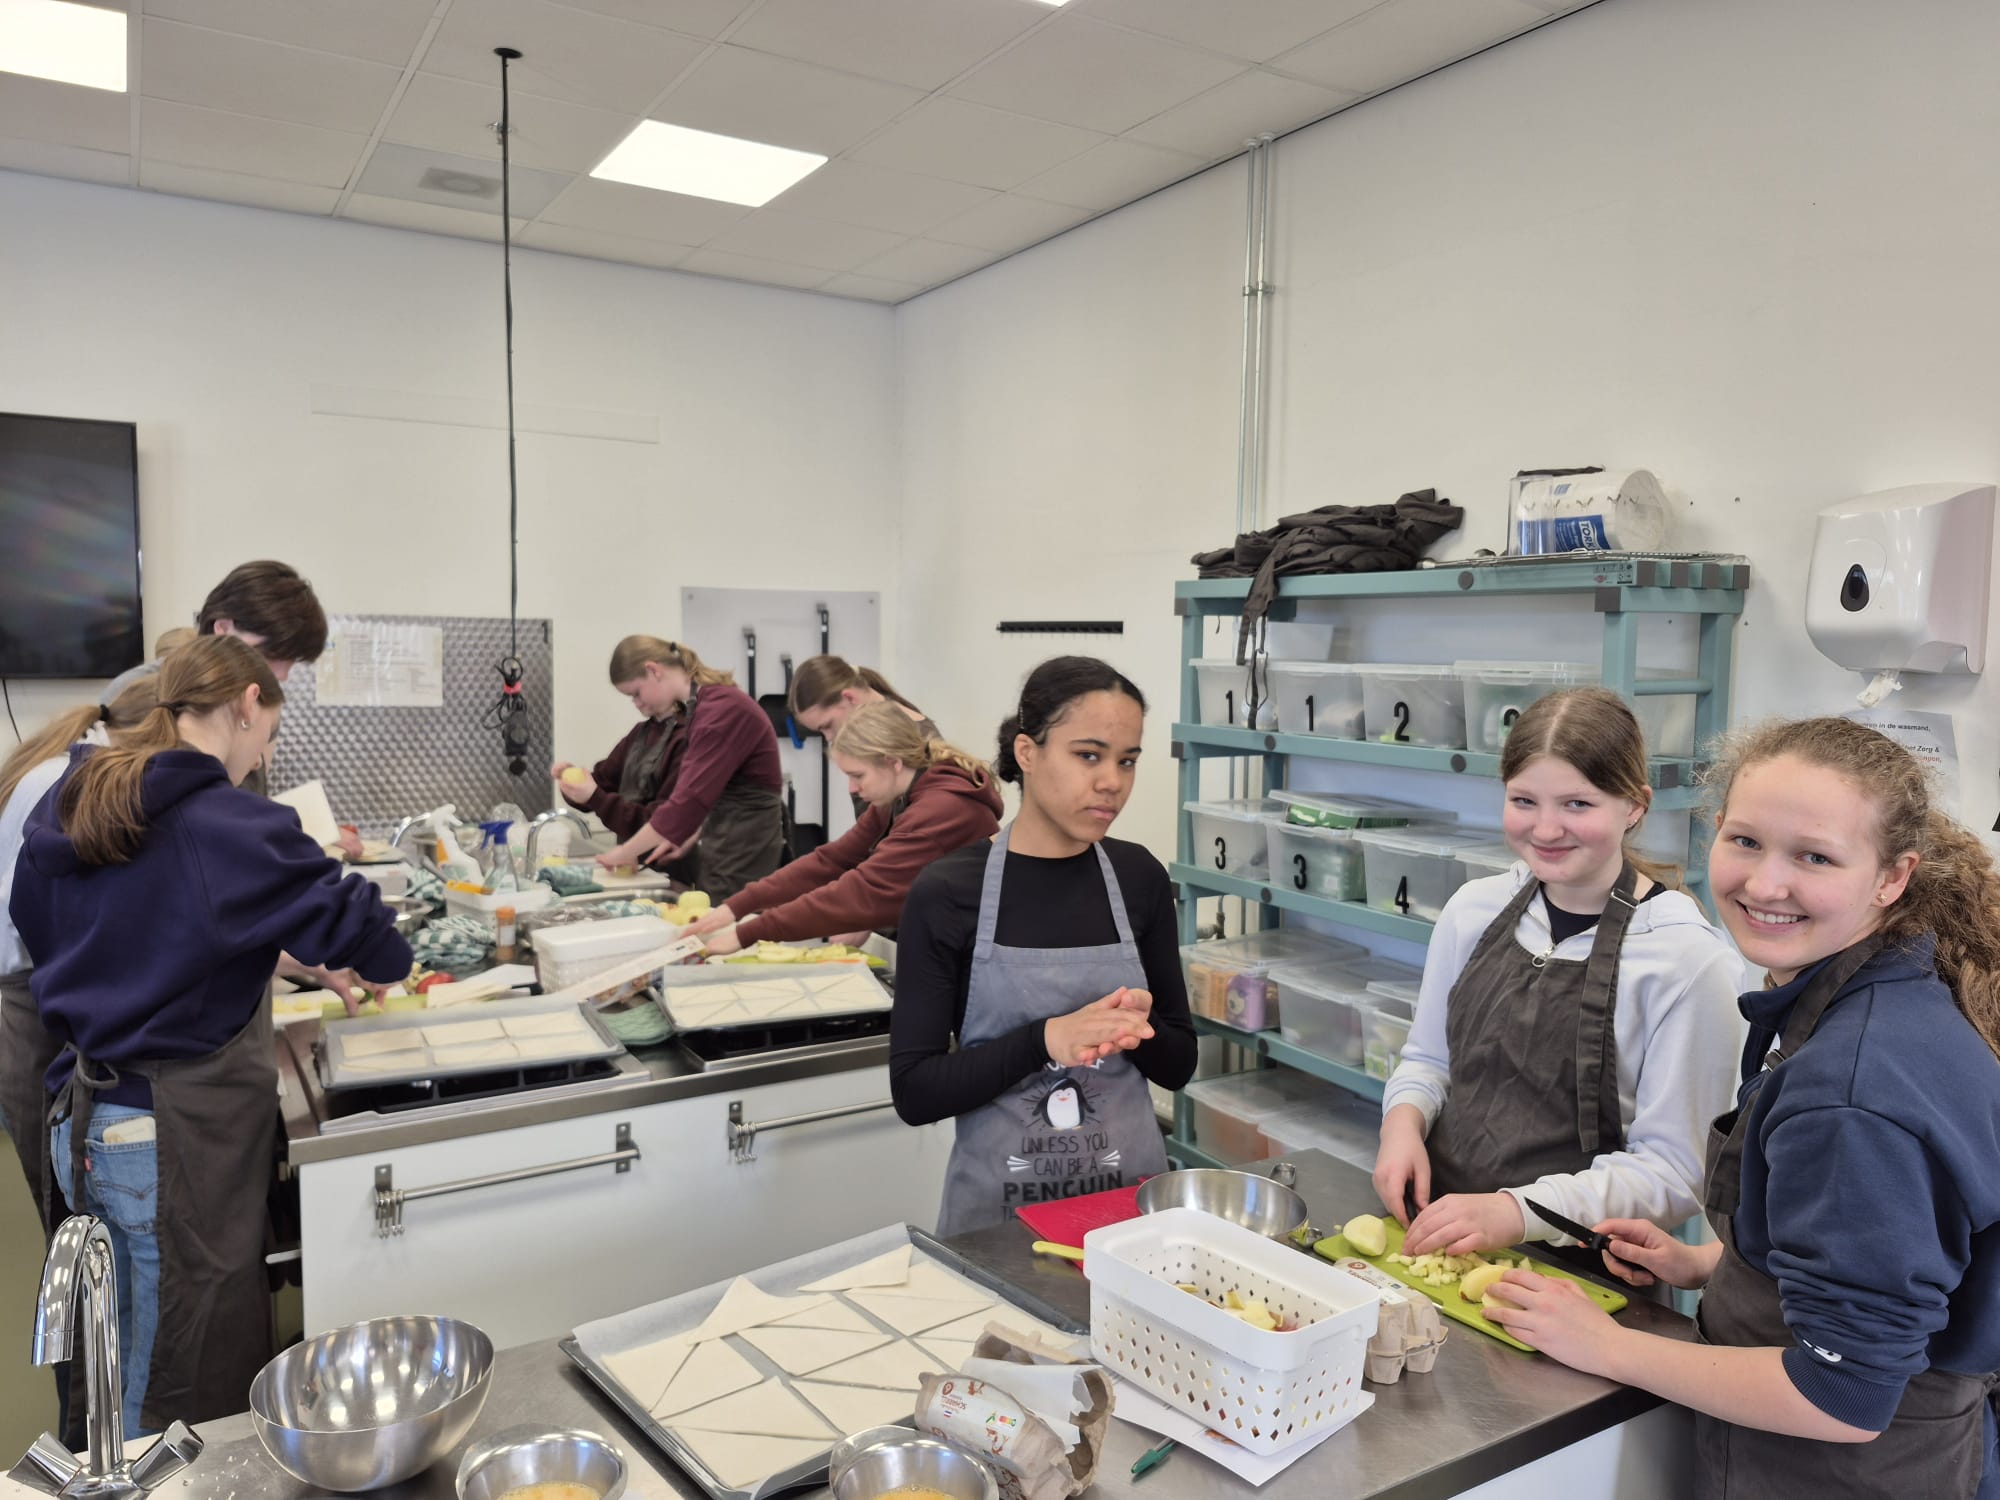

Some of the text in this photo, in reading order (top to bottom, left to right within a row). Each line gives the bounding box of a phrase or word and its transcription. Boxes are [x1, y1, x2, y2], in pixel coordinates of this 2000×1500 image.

[1581, 522, 1596, 548] TORK
[1225, 689, 1234, 725] 1
[1305, 694, 1314, 732] 1
[1393, 700, 1410, 742] 2
[1214, 836, 1226, 870] 3
[1293, 853, 1308, 891] 3
[1394, 875, 1411, 915] 4
[1021, 1131, 1108, 1154] UNLESS YOU
[1033, 1156, 1099, 1177] CAN BE A
[1002, 1170, 1123, 1202] PENGUIN
